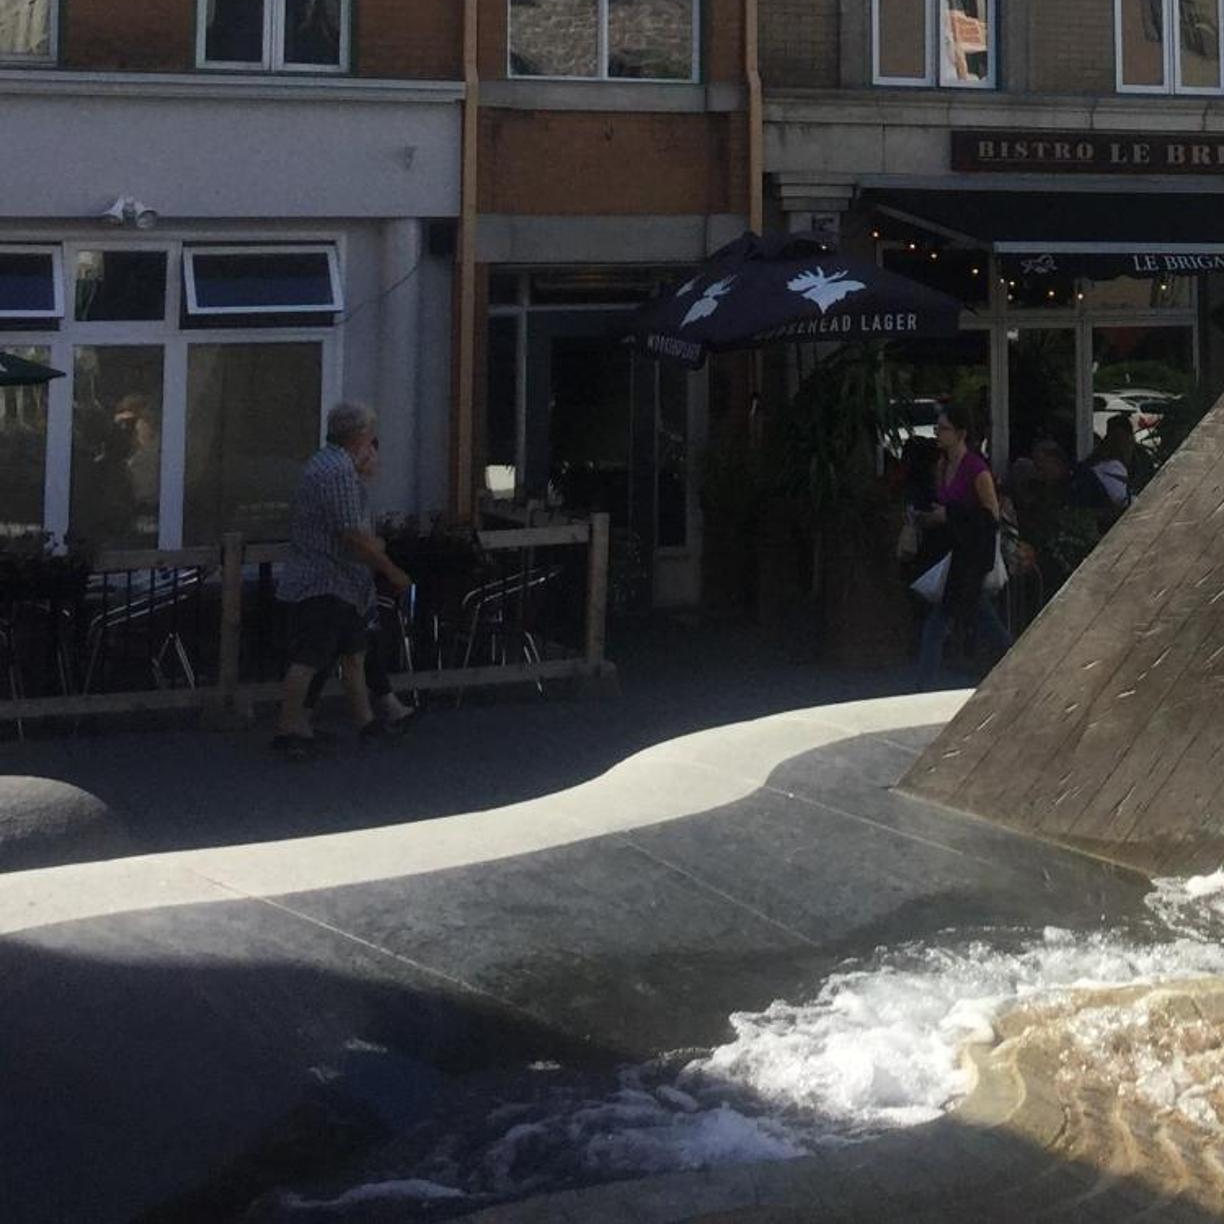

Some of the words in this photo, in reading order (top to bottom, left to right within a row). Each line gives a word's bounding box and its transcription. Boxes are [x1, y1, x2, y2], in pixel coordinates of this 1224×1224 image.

[977, 139, 1095, 162] BISTRO
[1110, 143, 1151, 164] LE
[1132, 255, 1159, 272] LE
[860, 313, 918, 331] LAGER
